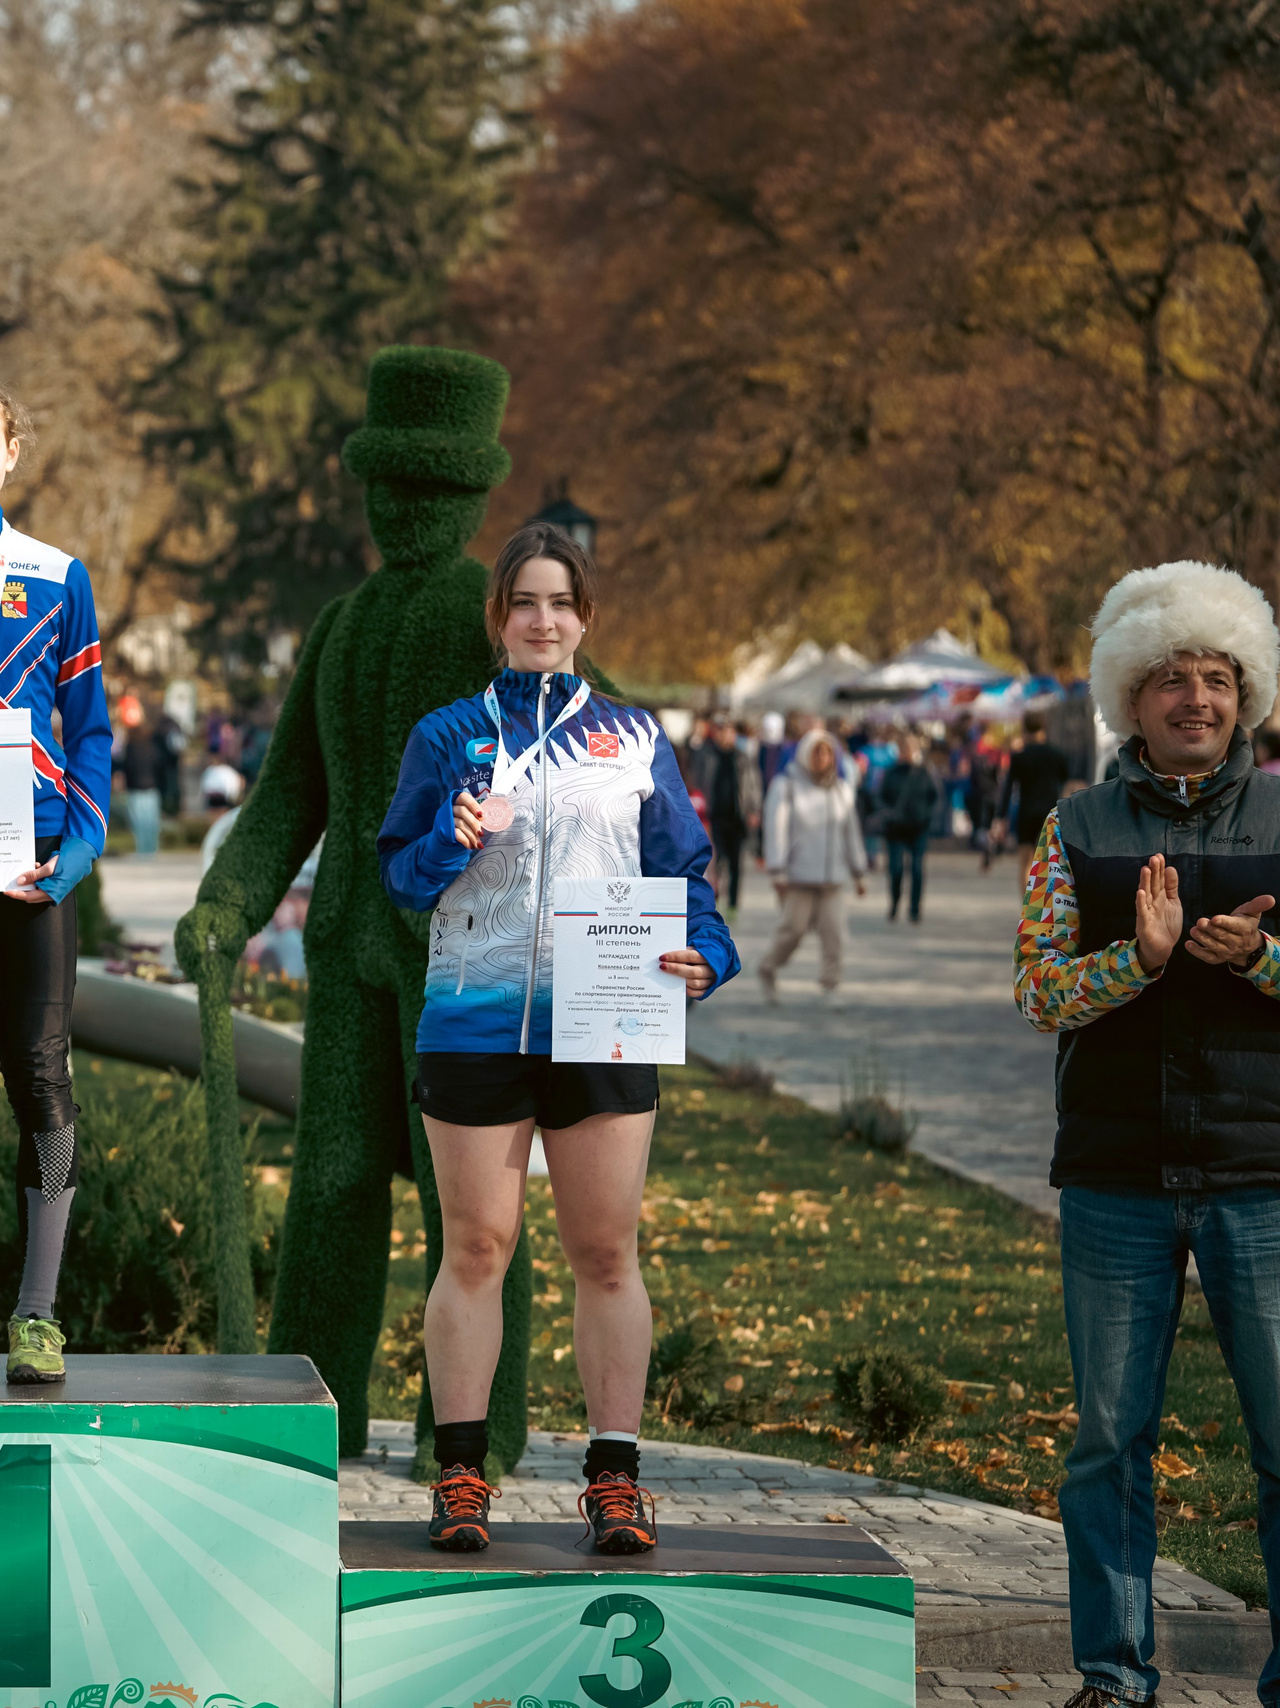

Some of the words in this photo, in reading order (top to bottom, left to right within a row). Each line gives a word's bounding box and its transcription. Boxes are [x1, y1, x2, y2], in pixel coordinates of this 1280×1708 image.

[9, 562, 40, 571] ОНЕЖ
[587, 925, 651, 936] ДИПЛОМ
[578, 1594, 672, 1708] 3
